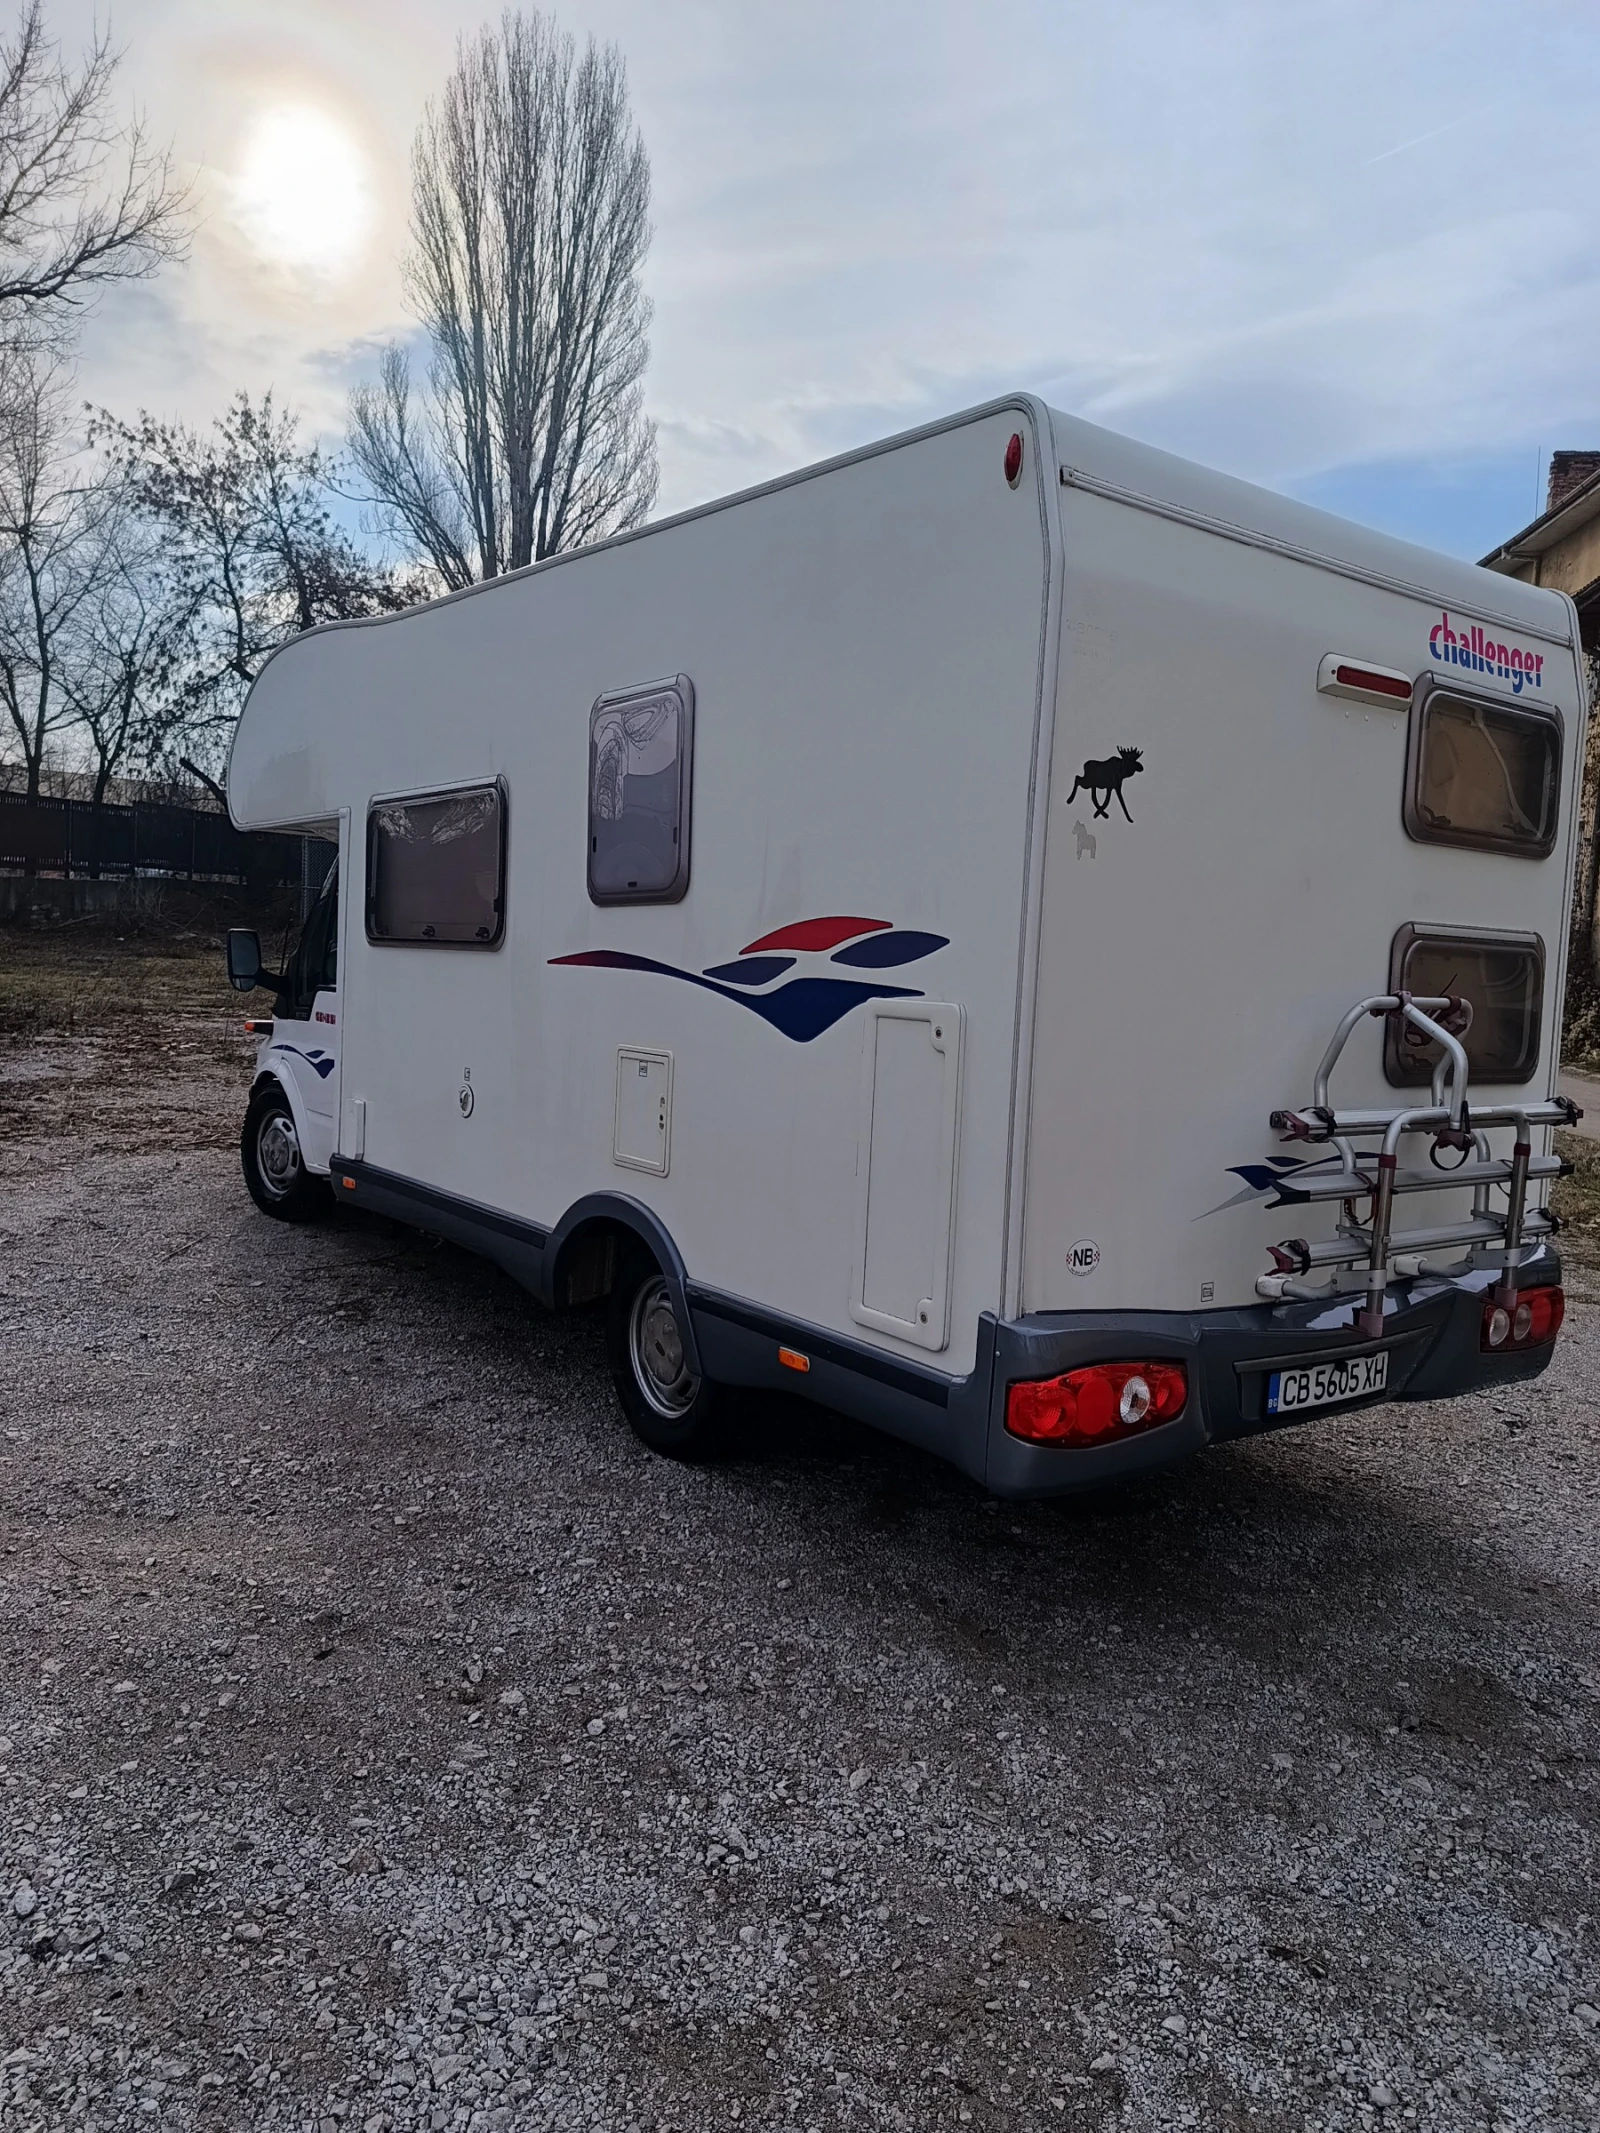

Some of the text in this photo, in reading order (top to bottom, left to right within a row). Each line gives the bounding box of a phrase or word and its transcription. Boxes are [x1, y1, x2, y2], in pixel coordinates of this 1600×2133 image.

[1429, 612, 1544, 694] challenger
[1073, 1248, 1093, 1267] NB
[1283, 1356, 1386, 1406] CB 5605 XH
[1268, 1398, 1278, 1408] BG
